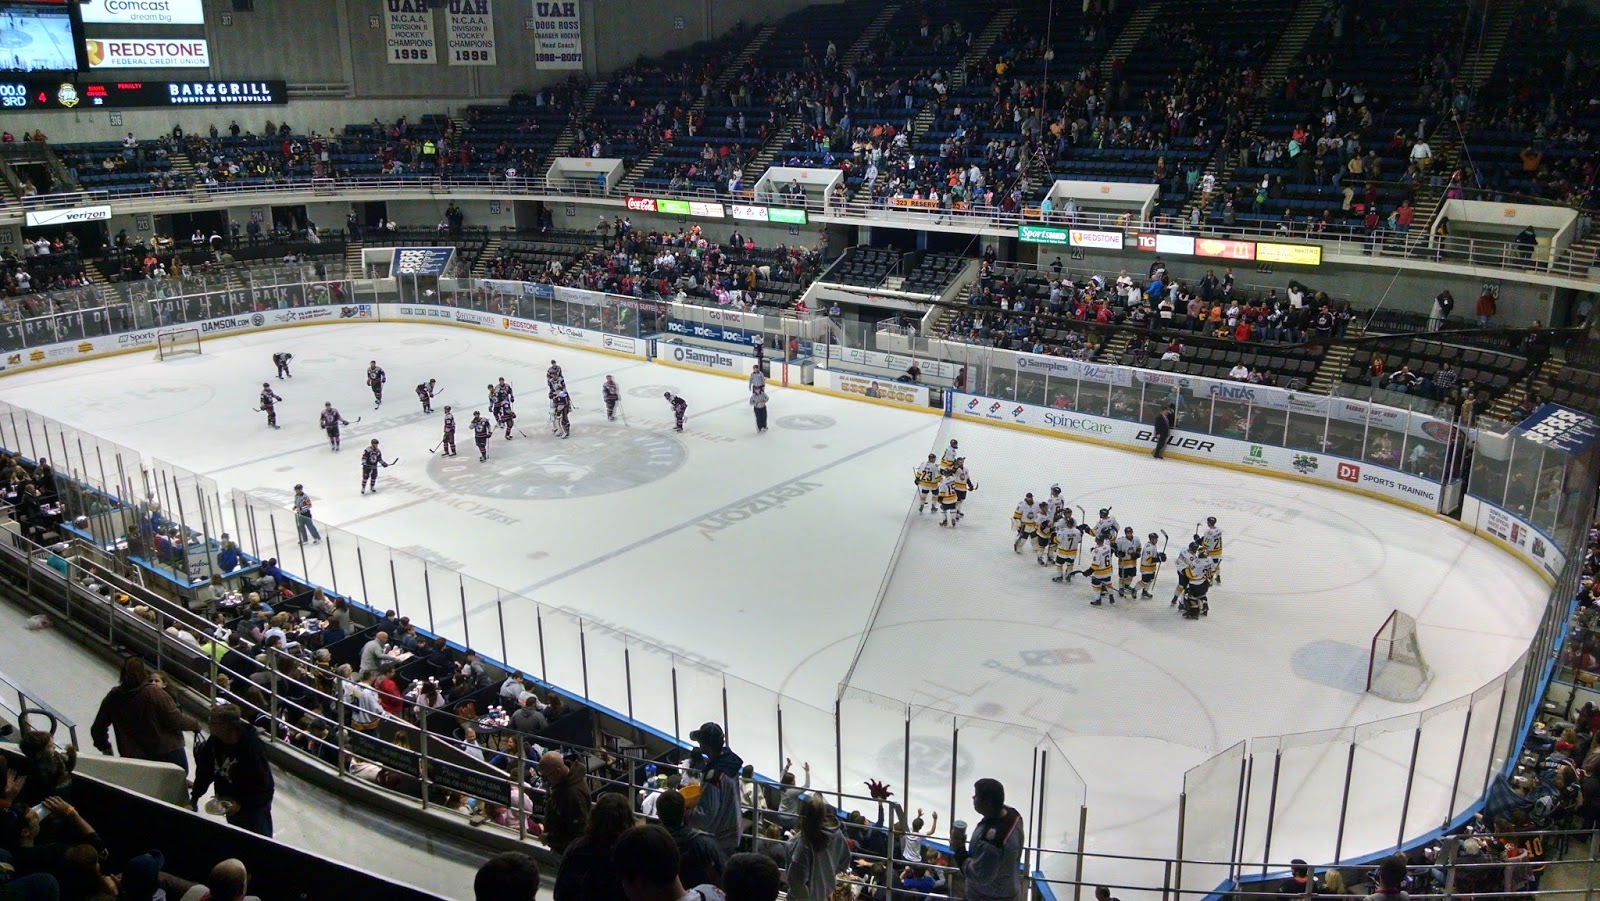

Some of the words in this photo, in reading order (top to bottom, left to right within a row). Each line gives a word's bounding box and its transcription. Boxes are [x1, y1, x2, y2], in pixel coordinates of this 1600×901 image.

[104, 0, 170, 14] comcast
[388, 0, 428, 12] UAH
[449, 0, 488, 14] UAH
[537, 2, 575, 17] UAH
[158, 14, 172, 22] big
[536, 21, 555, 30] DOUG
[558, 22, 578, 30] ROSS
[109, 43, 204, 56] REDSTONE
[394, 49, 428, 60] 1996
[456, 50, 488, 60] 1998
[169, 83, 271, 96] BAR&GRILL
[3, 96, 26, 106] 3RD
[38, 92, 46, 102] 4
[111, 116, 122, 125] 316
[66, 210, 106, 220] verizon
[138, 220, 148, 230] 213
[1084, 234, 1120, 243] REDSTONE
[1139, 236, 1156, 246] TIG
[476, 316, 496, 324] HOMES
[710, 311, 720, 320] GO
[510, 320, 538, 331] REDSTONE
[668, 322, 681, 332] TOC
[694, 326, 708, 336] TOC
[130, 331, 156, 342] Sports
[722, 331, 738, 341] TOC
[686, 348, 733, 367] Samples
[1028, 358, 1068, 372] Samples
[1551, 409, 1586, 423] TOC
[1044, 412, 1112, 434] SpineCare
[1541, 416, 1574, 430] TOC
[1531, 423, 1564, 437] TOC
[1520, 430, 1552, 444] TOC
[922, 470, 933, 482] 23
[1363, 474, 1394, 488] SPORTS
[1398, 484, 1434, 500] TRAINING
[1068, 538, 1074, 550] 7
[1104, 554, 1110, 567] 6
[1525, 836, 1543, 858] 10
